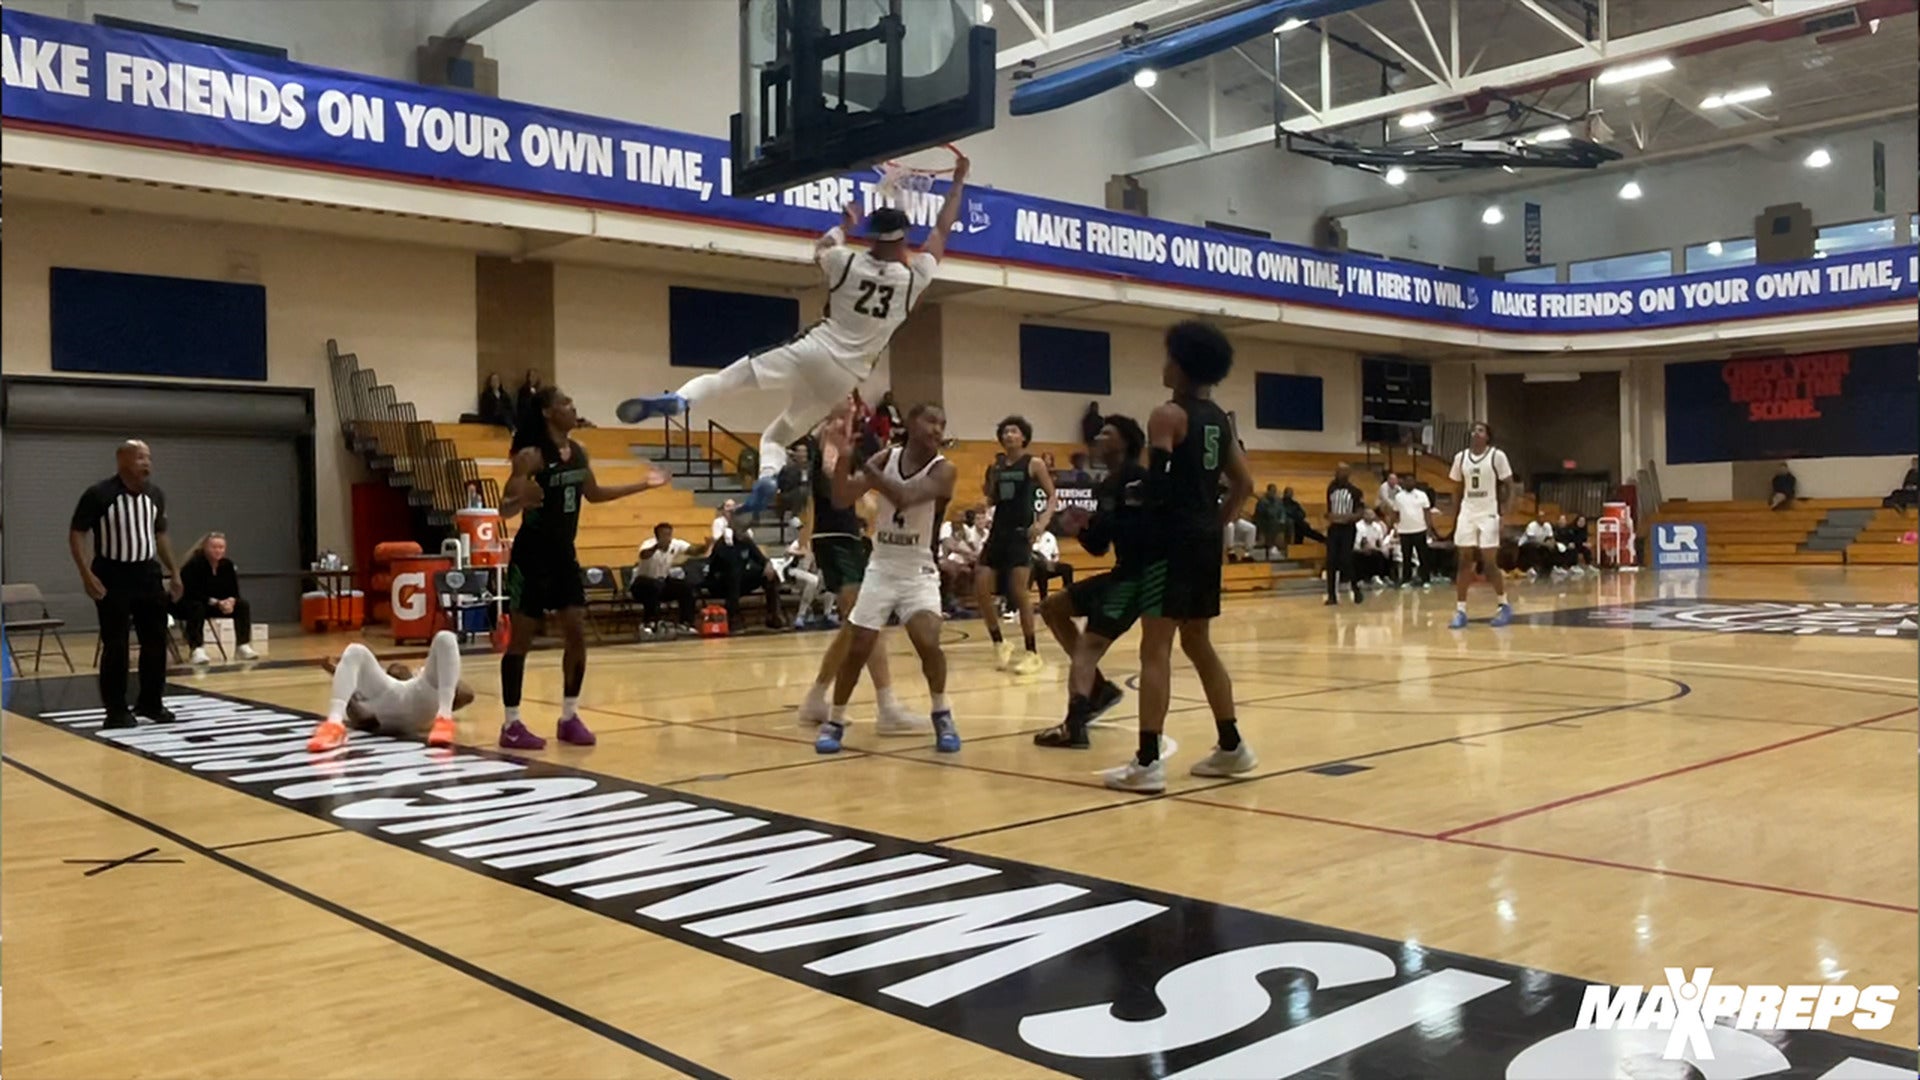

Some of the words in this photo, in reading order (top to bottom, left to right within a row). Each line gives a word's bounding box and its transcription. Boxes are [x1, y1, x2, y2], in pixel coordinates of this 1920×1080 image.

[2, 34, 90, 97] AKE
[106, 52, 306, 130] FRIENDS
[317, 89, 384, 143] ON
[396, 102, 511, 162] YOUR
[520, 124, 614, 178] OWN
[621, 140, 712, 201] TIME,
[1015, 208, 1081, 250] MAKE
[1086, 221, 1167, 264] FRIENDS
[1171, 236, 1199, 269] ON
[1203, 241, 1253, 277] YOUR
[1257, 251, 1298, 284] OWN
[1301, 258, 1344, 297] TIME,
[1347, 266, 1373, 297] I'M
[1376, 271, 1411, 302] HERE
[1414, 276, 1431, 304] TO
[1433, 280, 1465, 307] WIN.
[854, 280, 894, 319] 23
[1492, 289, 1537, 317] MAKE
[1541, 286, 1633, 317] FRIENDS
[1639, 286, 1675, 313] ON
[1681, 277, 1749, 308] YOUR
[1755, 268, 1820, 300] OWN
[1826, 259, 1902, 292] TIME,
[1203, 424, 1220, 470] 5
[477, 522, 493, 541] G
[391, 571, 427, 621] G
[331, 776, 1170, 1008] WINNING
